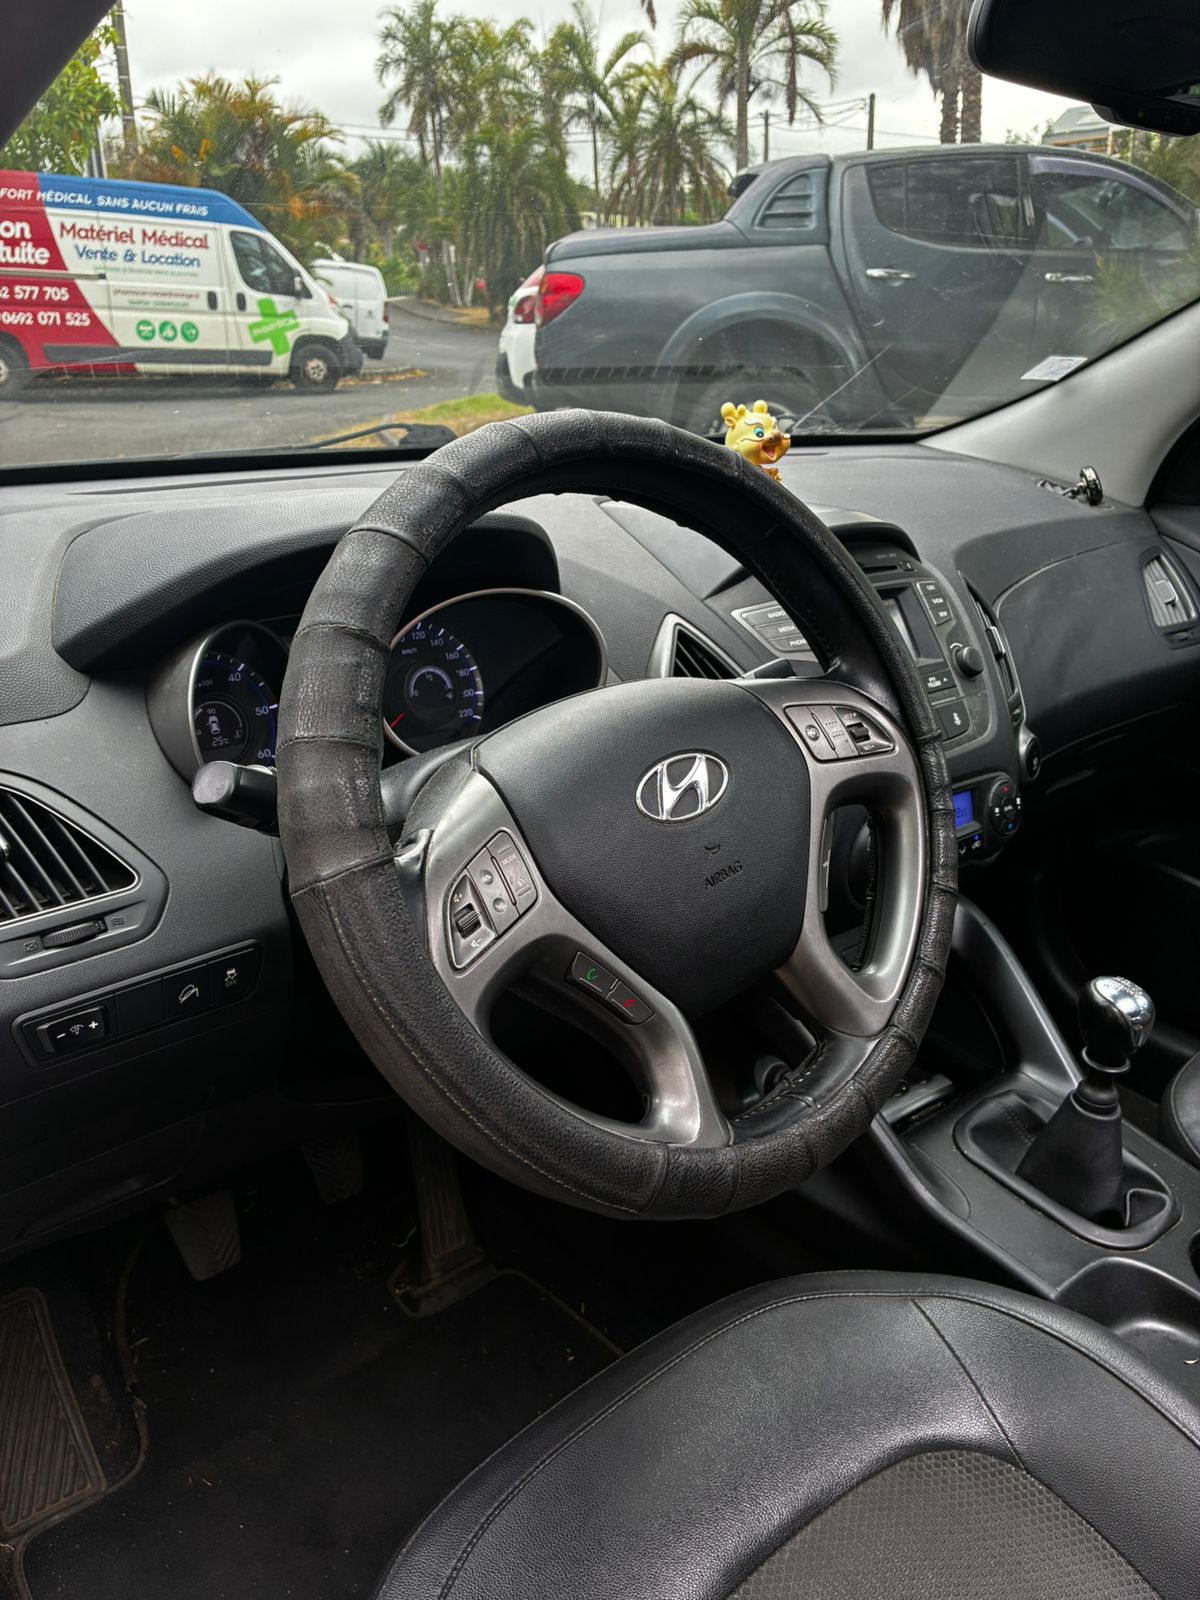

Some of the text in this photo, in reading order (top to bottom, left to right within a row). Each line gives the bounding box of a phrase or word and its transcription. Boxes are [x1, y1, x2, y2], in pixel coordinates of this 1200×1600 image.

[0, 187, 209, 217] FORT MÉDICAL SANS AUCUN FRAIS
[0, 220, 32, 239] on
[60, 222, 209, 249] Matériel Médical
[74, 244, 200, 267] Vente & Location
[14, 285, 39, 300] 577
[42, 286, 70, 301] 705
[1, 311, 91, 327] 0692 071 525
[411, 632, 426, 640] 120
[430, 638, 444, 647] 140
[445, 651, 460, 660] 160
[228, 672, 242, 682] 40
[255, 705, 269, 716] 50
[257, 748, 271, 759] 60
[705, 860, 743, 889] AIRBAG
